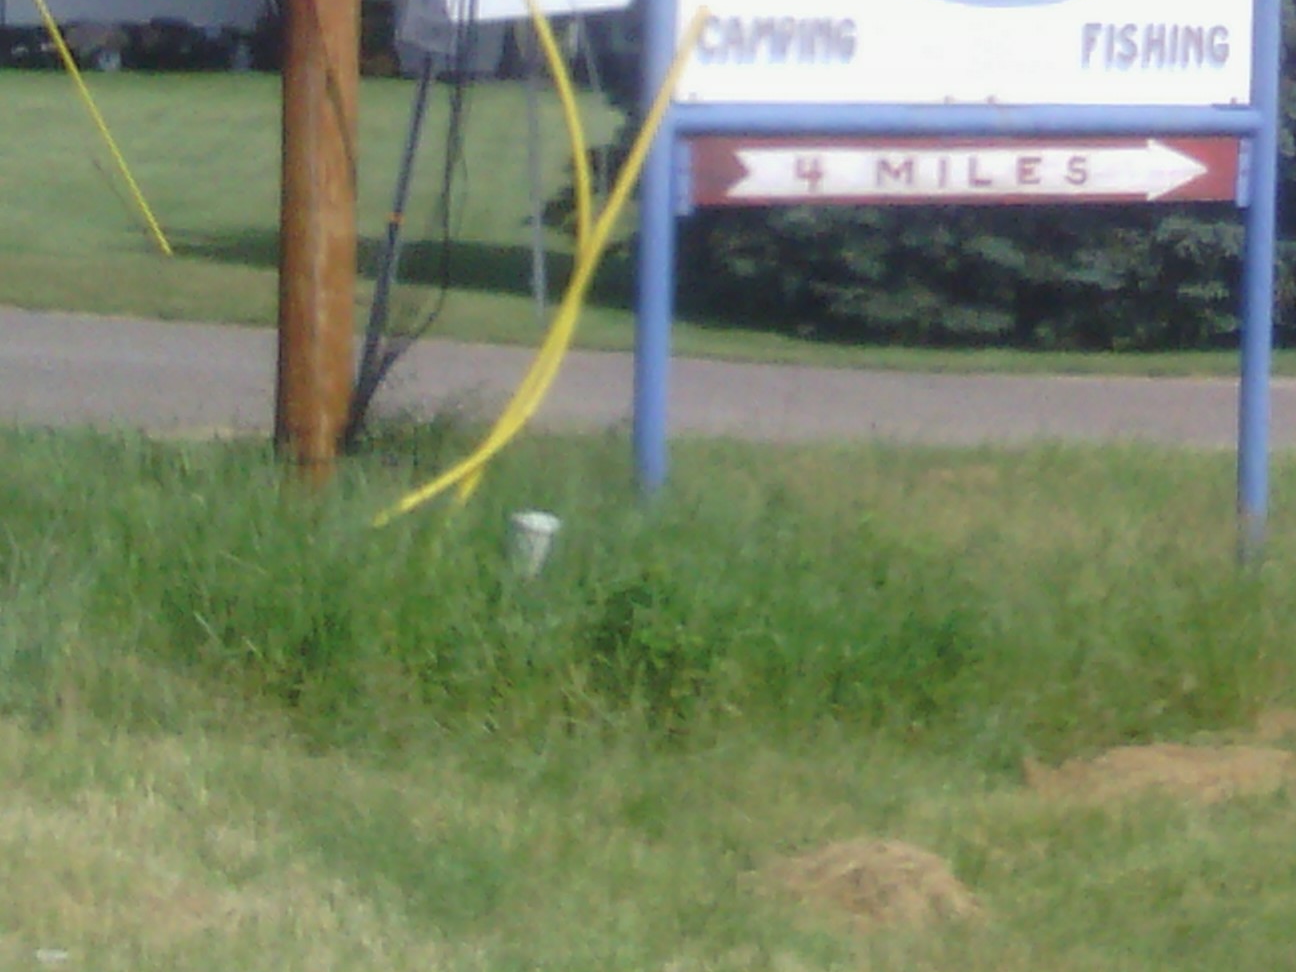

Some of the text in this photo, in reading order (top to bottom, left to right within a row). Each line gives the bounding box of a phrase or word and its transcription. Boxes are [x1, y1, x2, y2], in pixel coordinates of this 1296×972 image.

[697, 14, 857, 64] CAMPING
[1080, 22, 1230, 69] FISHING
[794, 155, 1089, 193] 4 MILES
